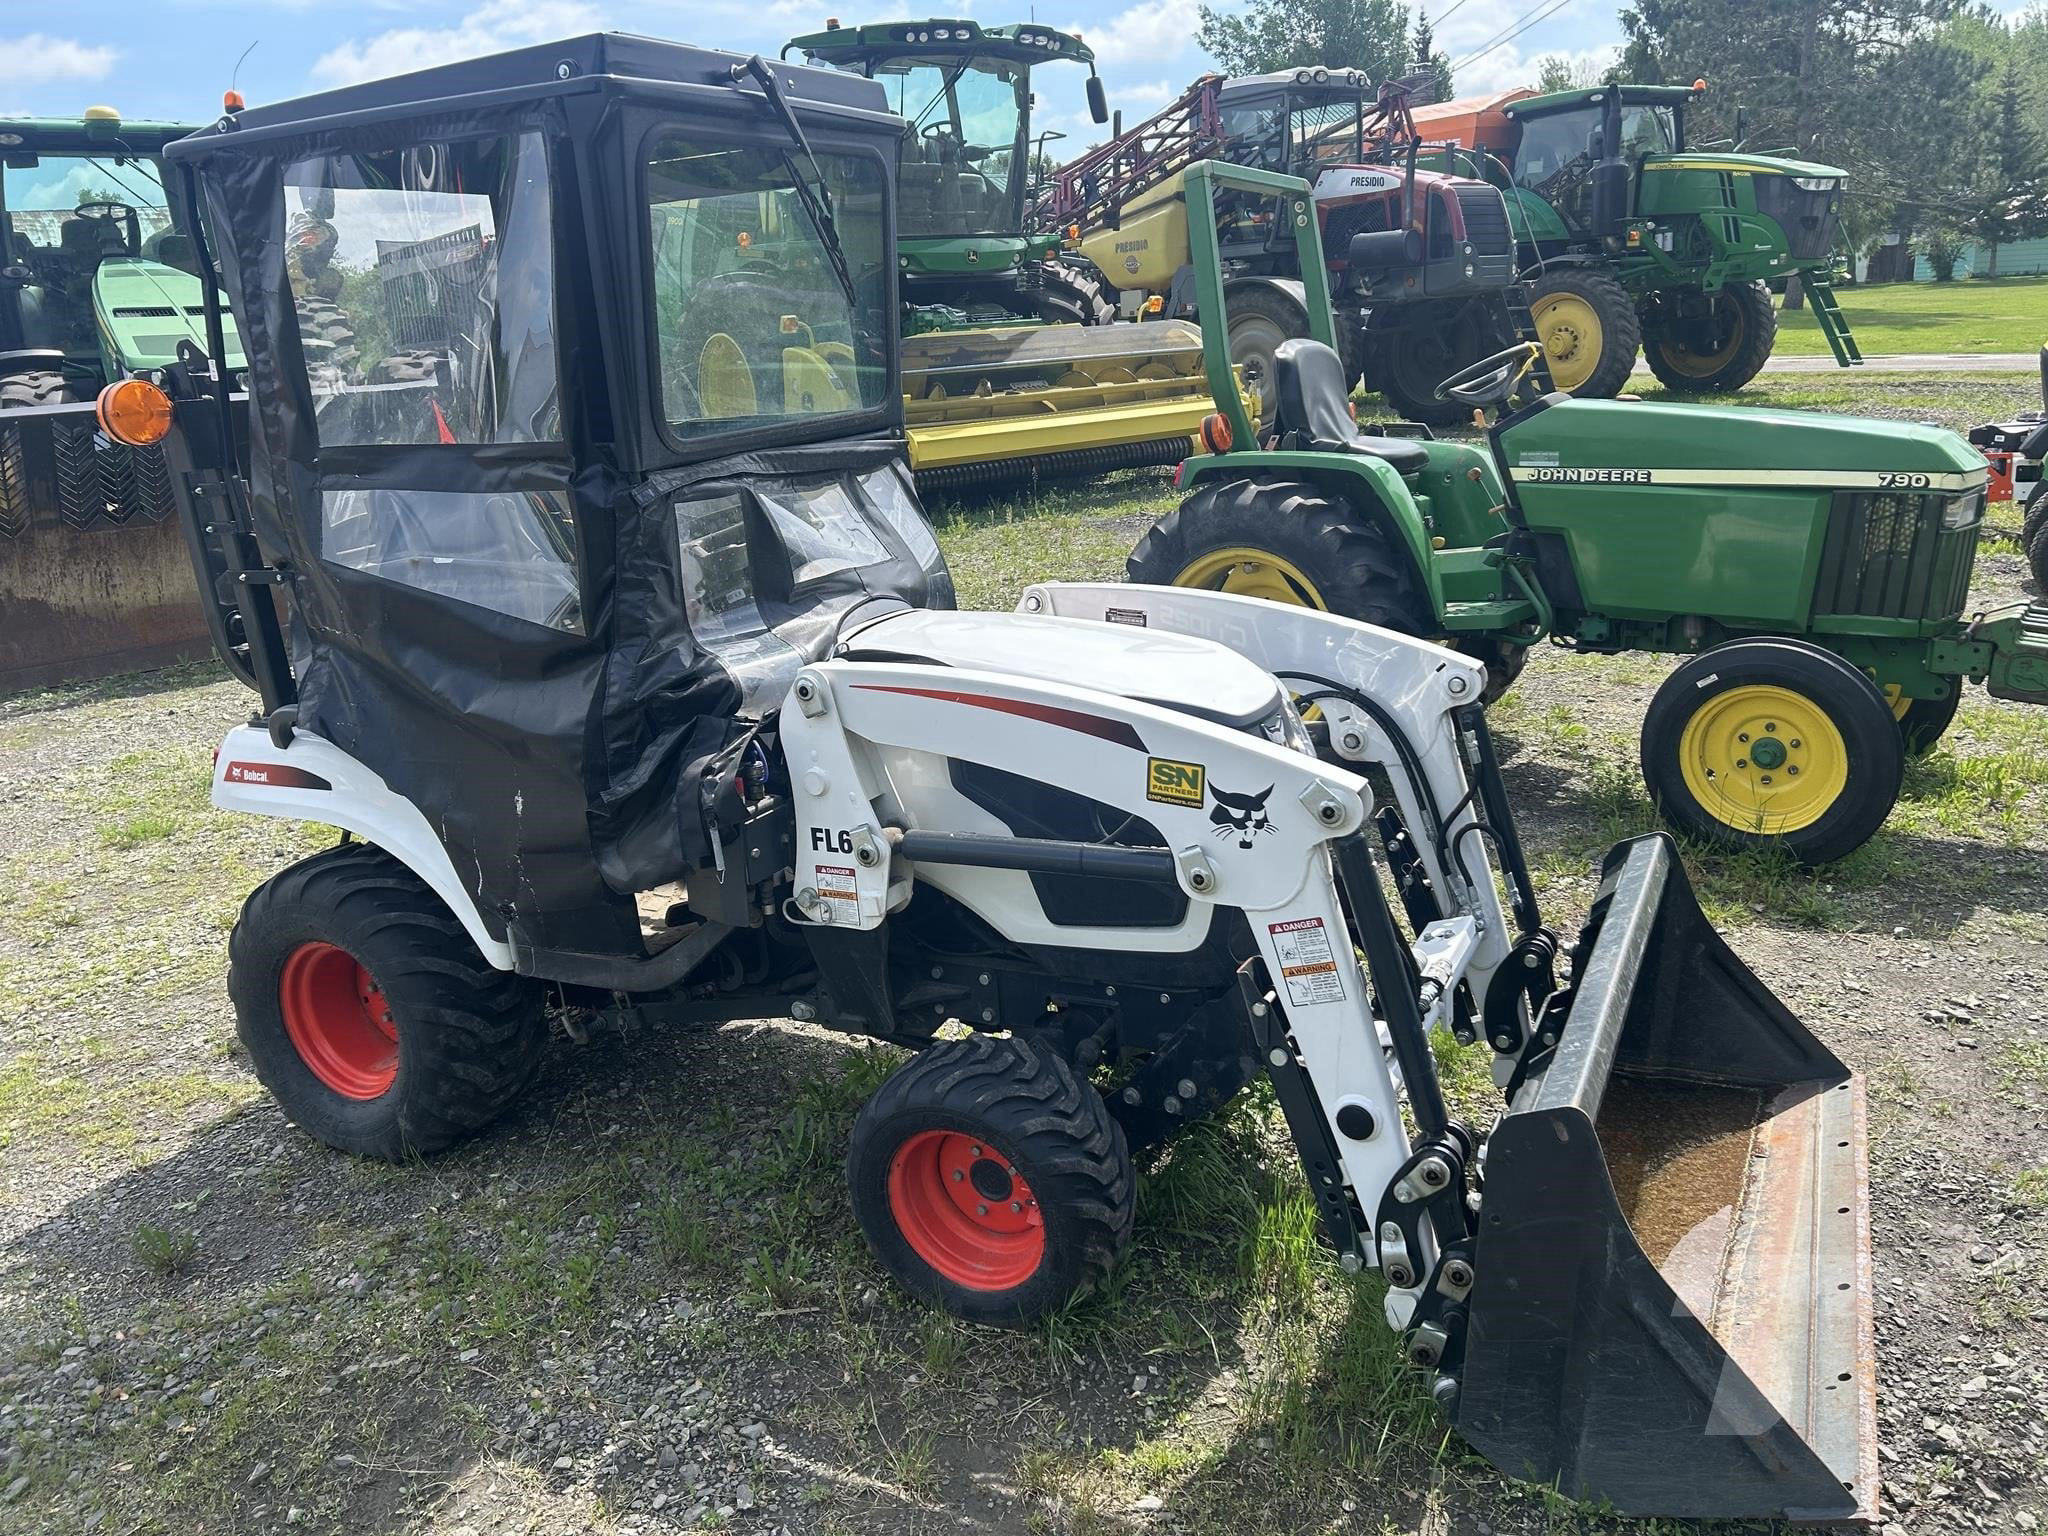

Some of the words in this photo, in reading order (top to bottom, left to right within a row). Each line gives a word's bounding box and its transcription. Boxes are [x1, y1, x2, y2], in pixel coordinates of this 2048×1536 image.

[1350, 176, 1385, 187] PRESIDIO
[1115, 239, 1149, 254] PRESIDIO
[1528, 468, 1582, 482] JOHN
[1584, 469, 1652, 483] DEERE
[1878, 473, 1931, 489] 790
[243, 769, 268, 782] Bobcat
[1152, 784, 1199, 797] PARTNERS
[1147, 793, 1203, 808] SNPartners.com
[810, 827, 854, 854] FL6
[826, 867, 850, 875] DANGER
[828, 891, 854, 900] WARNING
[1282, 919, 1319, 931] DANGER
[1294, 963, 1332, 975] WARNING
